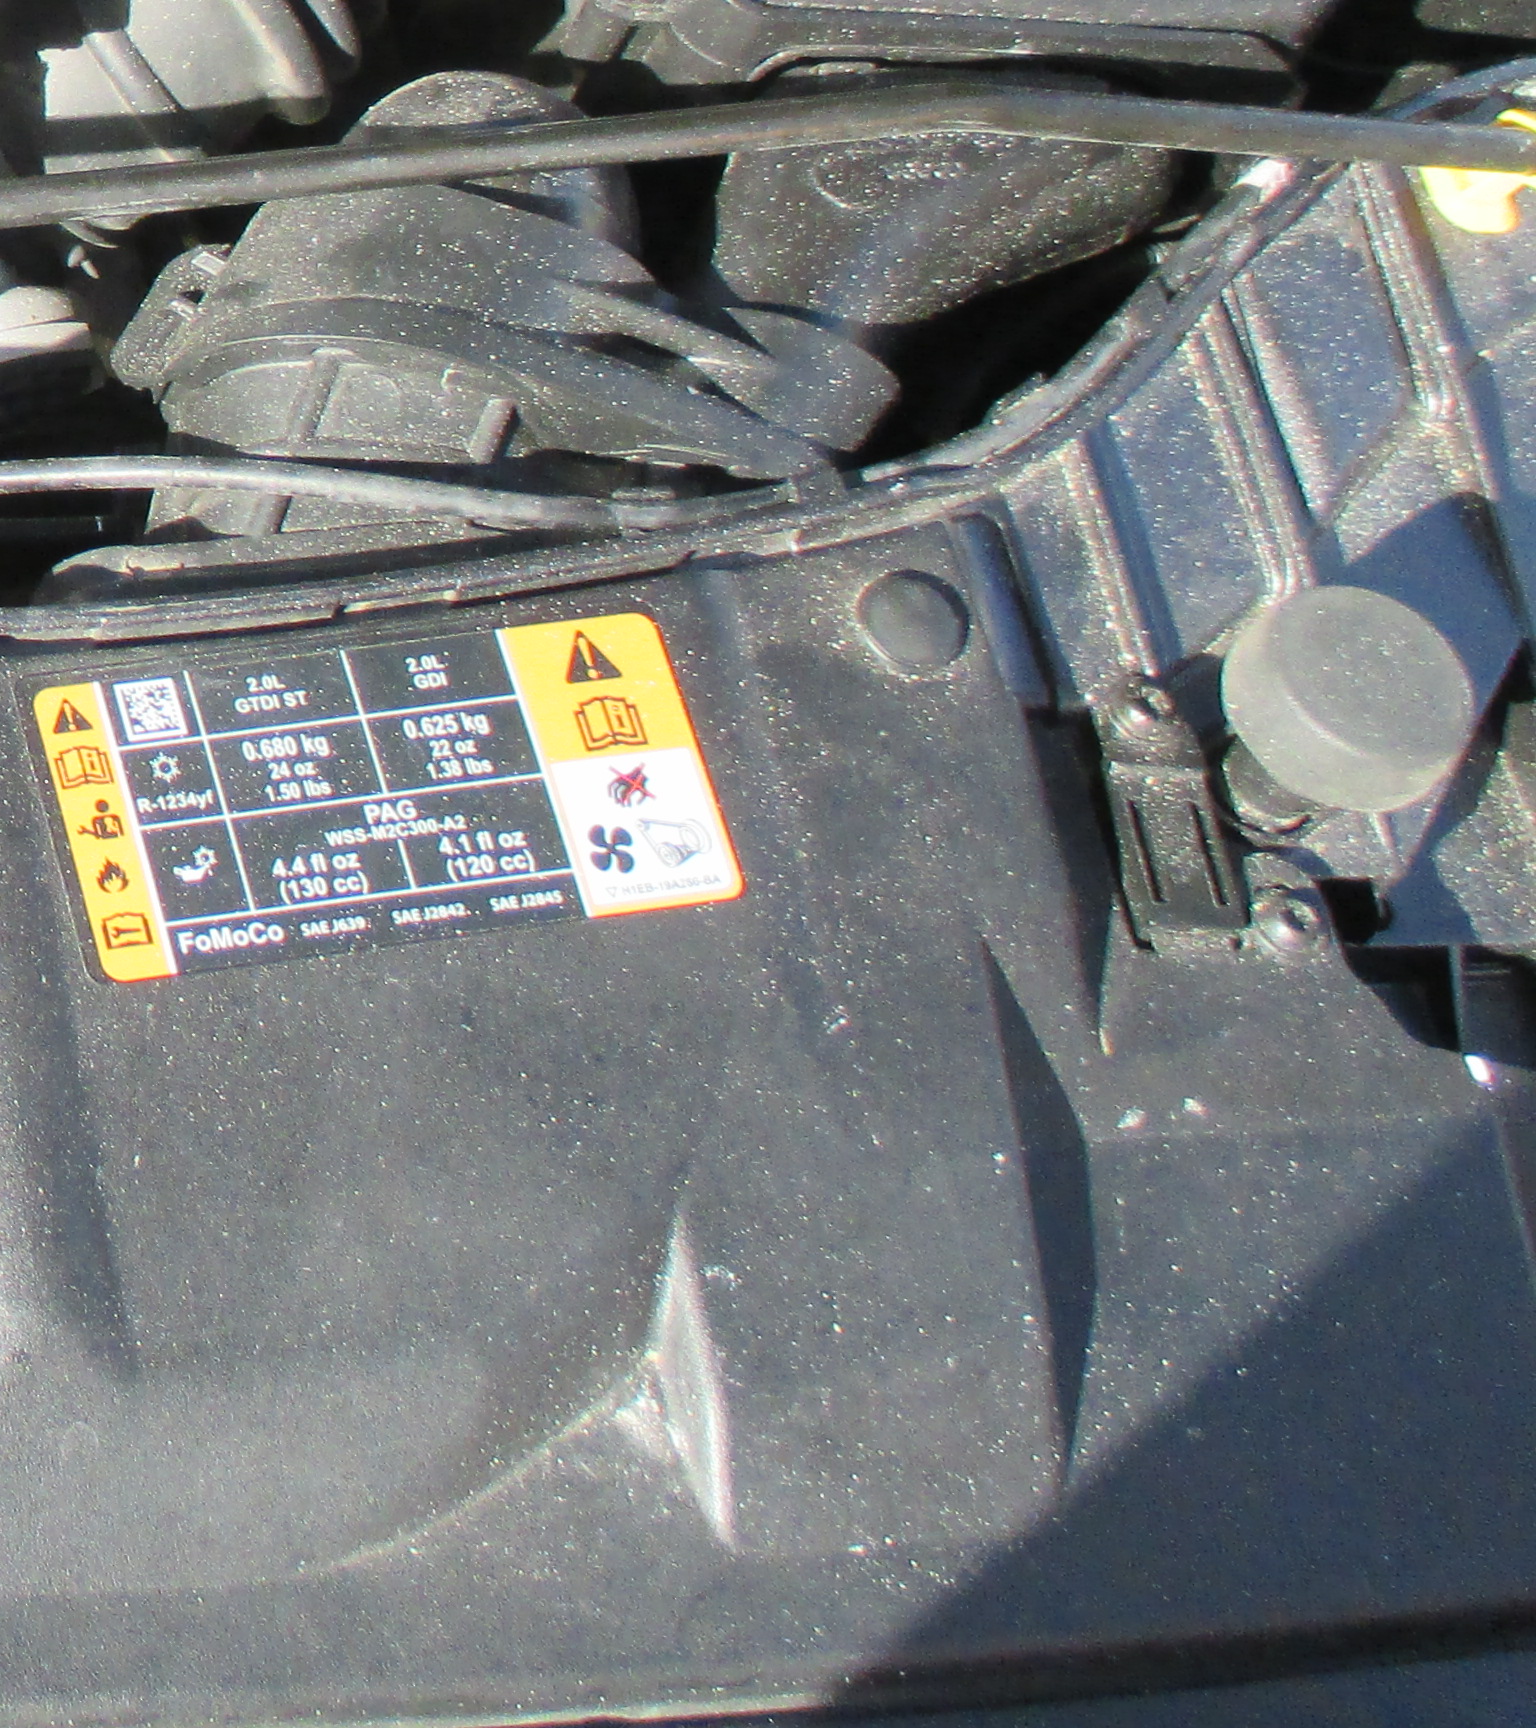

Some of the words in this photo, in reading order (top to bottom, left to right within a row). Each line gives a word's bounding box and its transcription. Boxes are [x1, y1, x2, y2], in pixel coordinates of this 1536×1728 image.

[404, 654, 444, 673] 2.0L
[245, 674, 287, 693] 2.0L
[413, 672, 450, 690] GDI
[233, 694, 281, 714] GTDI
[283, 690, 309, 707] ST
[402, 713, 459, 740] 0.625
[460, 711, 493, 736] kg
[241, 737, 298, 761] 0.680
[300, 733, 333, 757] kg
[429, 738, 452, 758] 22
[454, 739, 478, 754] oz
[268, 762, 291, 780] 24
[293, 762, 317, 777] oz
[425, 758, 464, 780] 1.38
[464, 757, 495, 776] lbs
[136, 788, 215, 814] R-1234yf
[264, 781, 301, 803] 1.50
[302, 779, 334, 798] lbs
[363, 799, 420, 825] PAG
[324, 813, 468, 847] WSS-M2C300-A2
[438, 833, 474, 856] 4.1
[475, 830, 495, 851] fl
[498, 830, 528, 848] oz
[271, 855, 309, 879] 4.4
[310, 852, 329, 874] fl
[332, 852, 361, 870] oz
[446, 854, 497, 883] (120
[499, 848, 536, 872] cc)
[279, 875, 329, 905] (130
[332, 869, 370, 895] cc)
[488, 895, 519, 913] SAE
[299, 920, 330, 938] SAE
[330, 915, 366, 936] J639
[390, 908, 421, 926] SAE
[178, 922, 288, 955] FoMoCo
